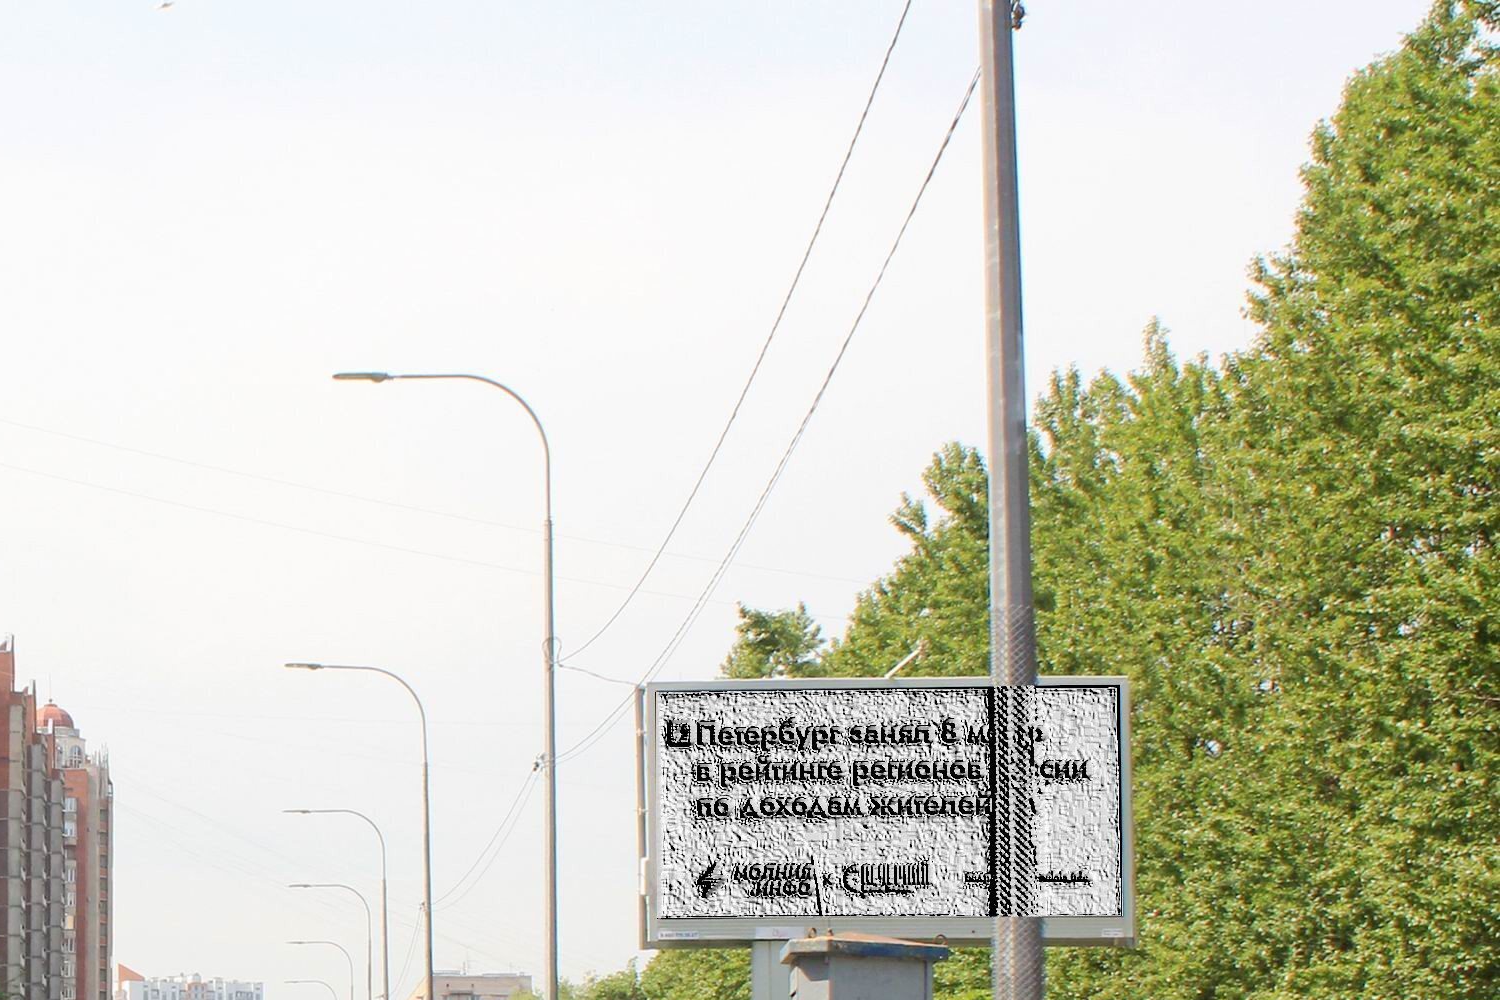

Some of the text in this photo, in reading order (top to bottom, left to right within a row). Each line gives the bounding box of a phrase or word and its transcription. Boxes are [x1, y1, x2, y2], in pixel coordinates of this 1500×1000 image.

[696, 717, 845, 751] Петербург
[849, 724, 931, 745] занял
[696, 762, 712, 782] в
[720, 754, 842, 787] рейтинге
[852, 760, 982, 788] регионов
[696, 798, 729, 817] по
[739, 797, 863, 820] доходам
